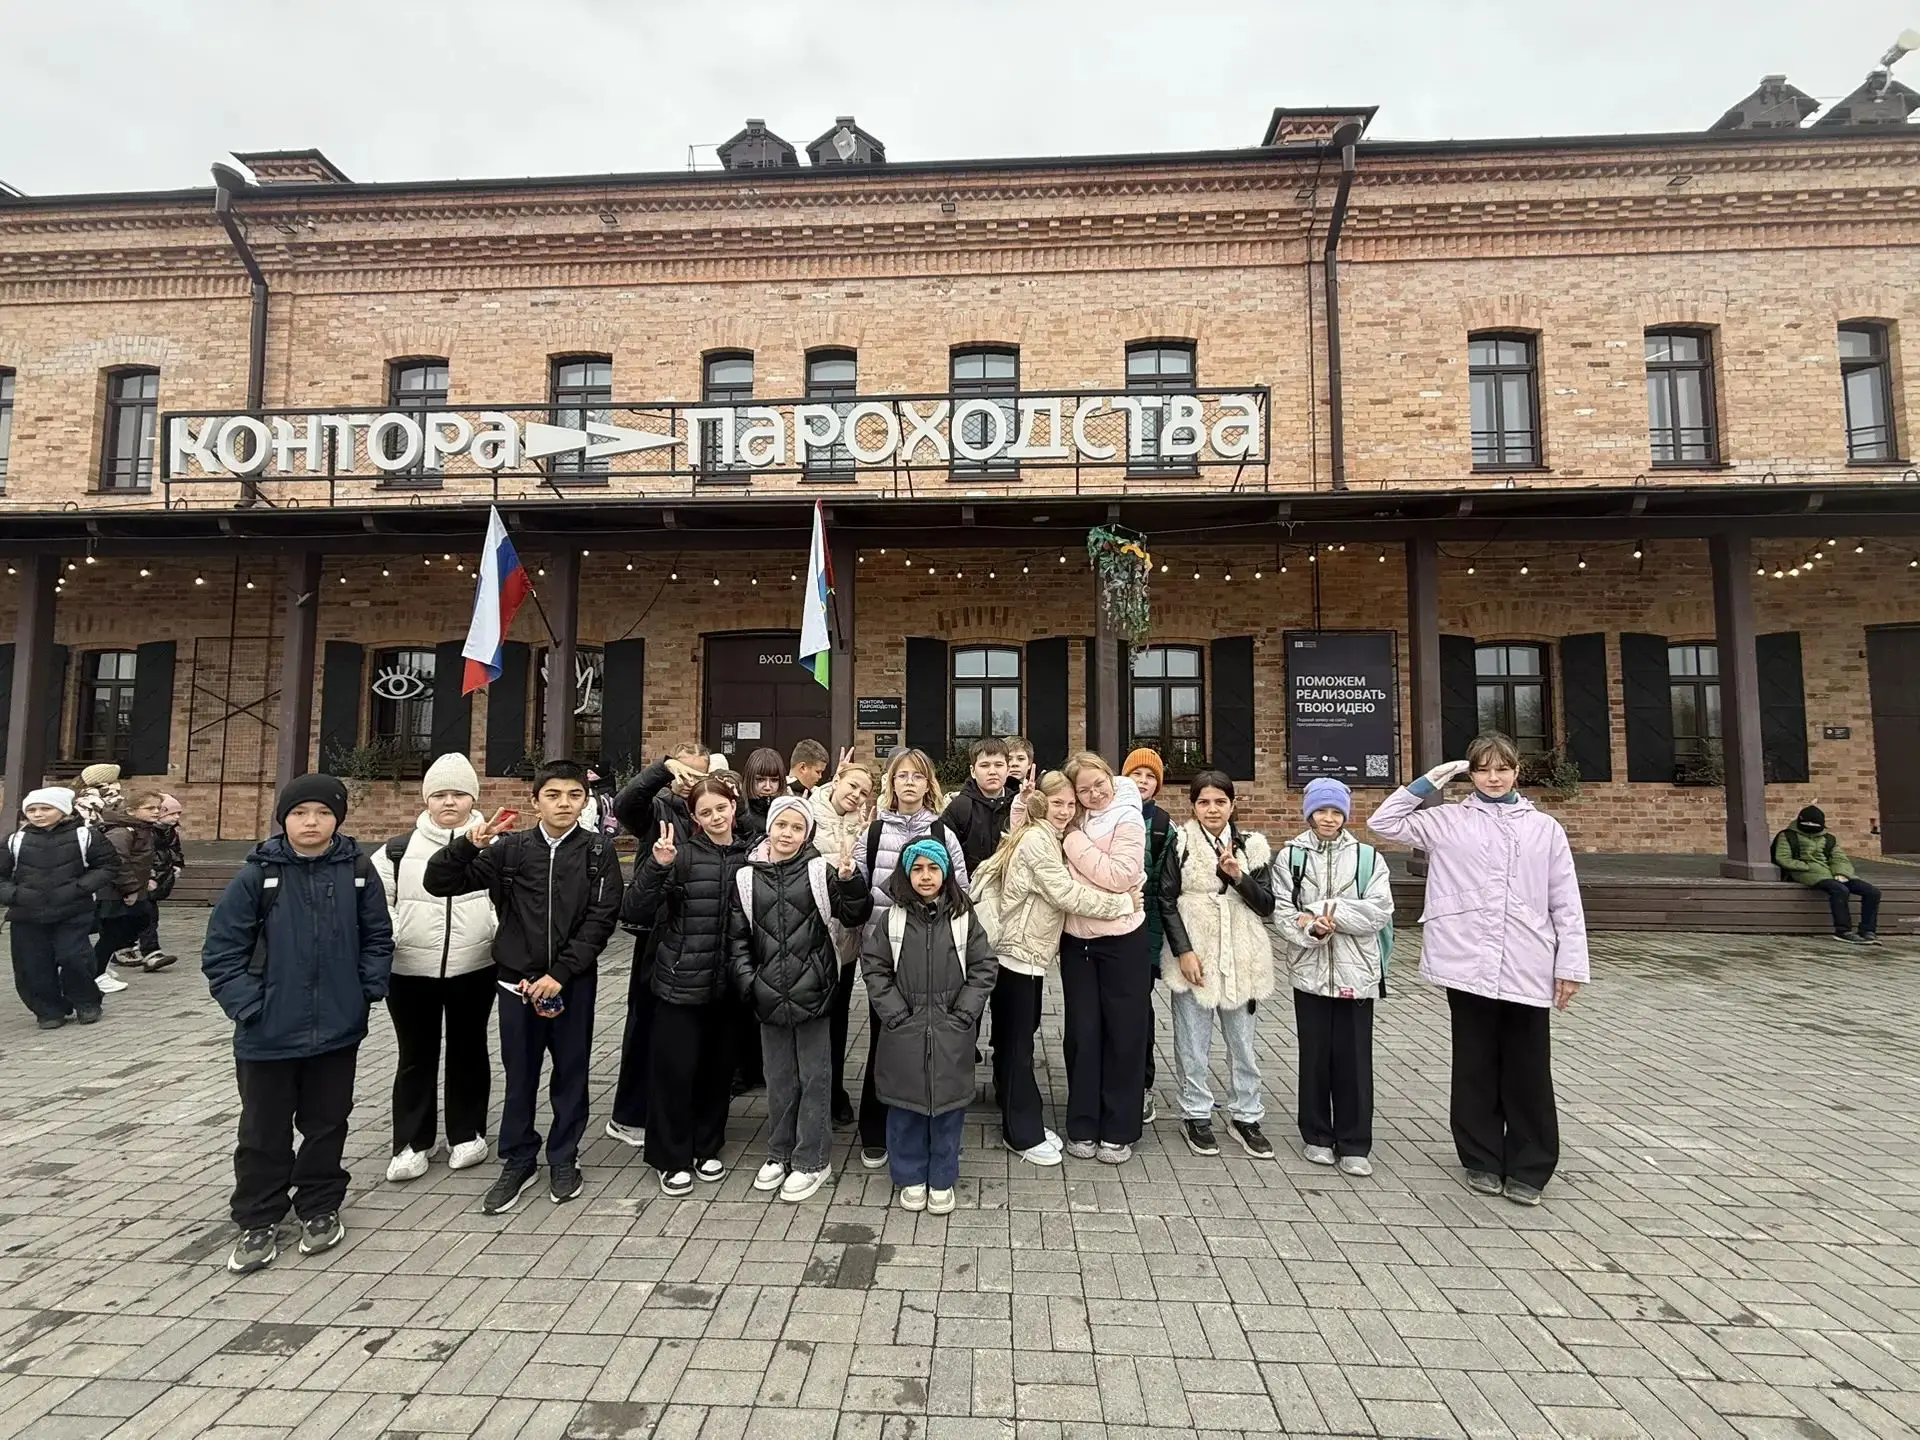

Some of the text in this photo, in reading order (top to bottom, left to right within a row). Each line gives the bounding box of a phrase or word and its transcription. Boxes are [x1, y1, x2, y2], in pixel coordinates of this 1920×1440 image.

[1296, 676, 1366, 687] ПОМОЖЕМ
[1296, 689, 1386, 700] РЕАЛИЗОВАТЬ
[1296, 702, 1376, 715] ТВОЮ ИДЕЮ
